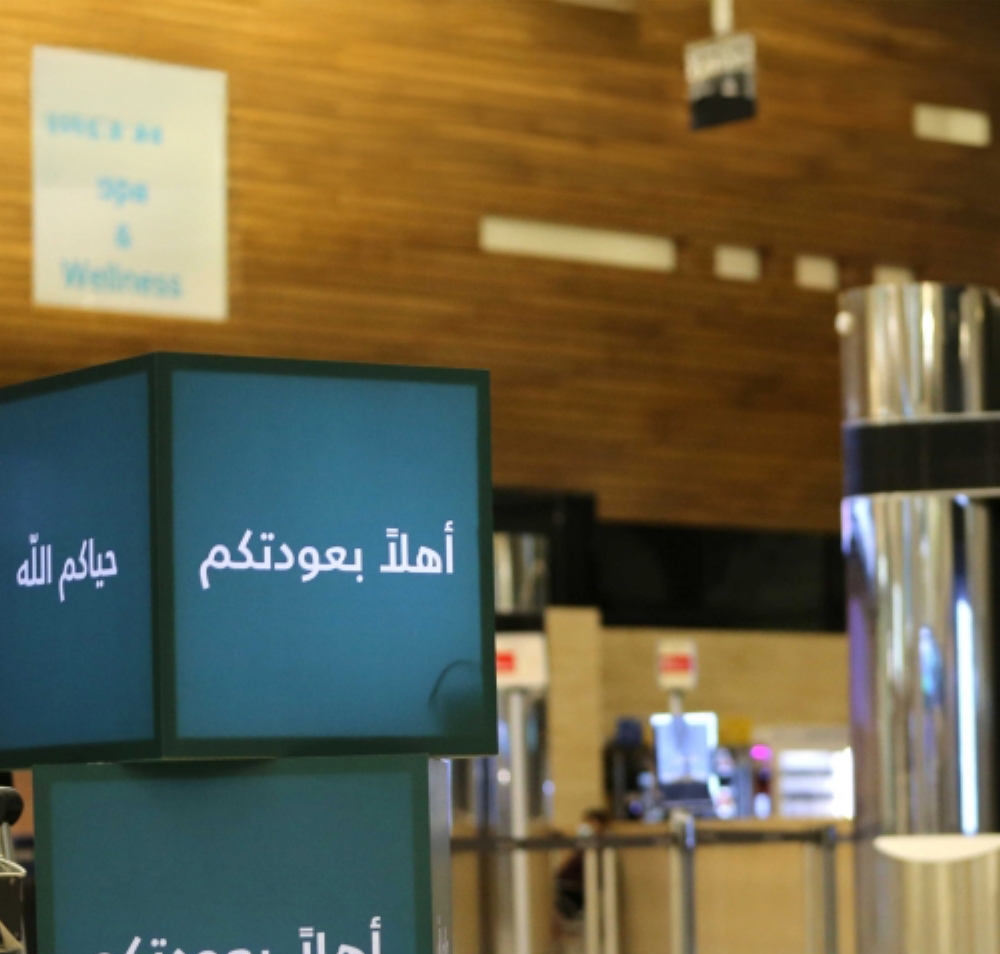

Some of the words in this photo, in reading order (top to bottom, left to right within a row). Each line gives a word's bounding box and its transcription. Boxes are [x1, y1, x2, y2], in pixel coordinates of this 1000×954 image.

[62, 259, 181, 297] Wellness
[58, 538, 118, 602] حياكم
[199, 529, 363, 589] بعودتكم
